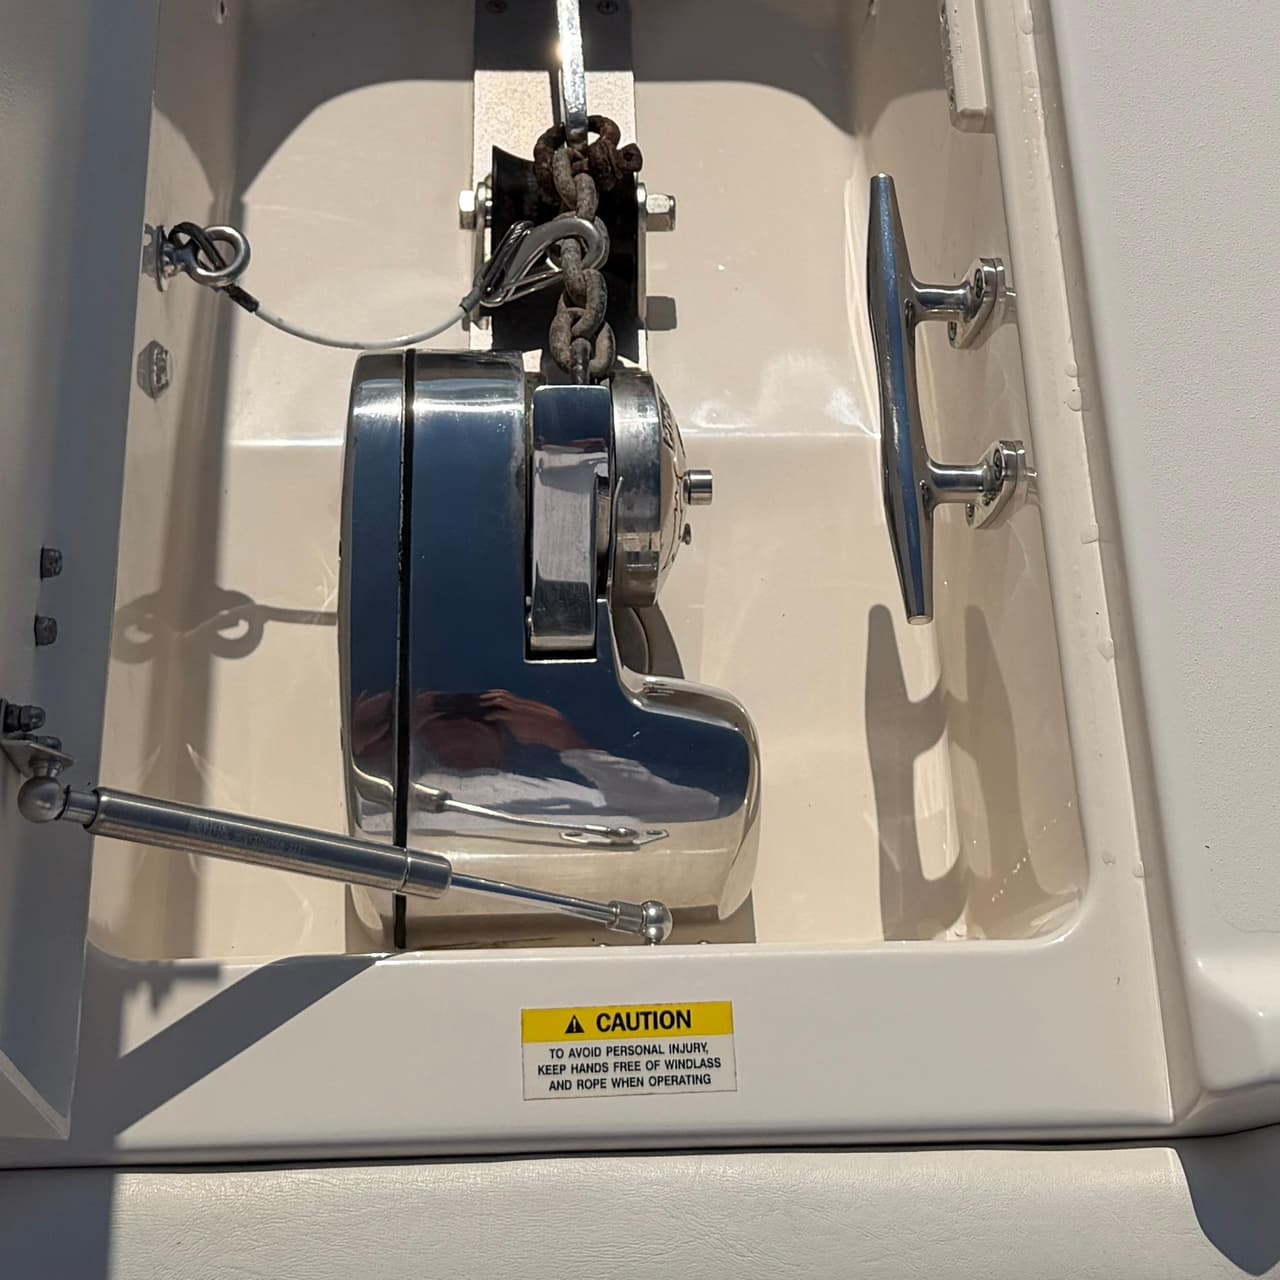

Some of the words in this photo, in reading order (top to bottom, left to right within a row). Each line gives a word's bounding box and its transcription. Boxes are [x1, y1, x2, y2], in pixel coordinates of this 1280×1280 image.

[596, 1009, 692, 1032] CAUTION
[549, 1048, 565, 1060] TO
[568, 1047, 602, 1059] AVOID
[606, 1044, 665, 1057] PERSONAL
[669, 1041, 709, 1055] INJURY,
[537, 1064, 567, 1076] KEEP
[571, 1062, 609, 1075] HANDS
[613, 1060, 642, 1073] FREE
[645, 1059, 661, 1071] OF
[664, 1057, 722, 1071] WINDLASS
[549, 1079, 573, 1092] AND
[577, 1078, 608, 1090] ROPE
[611, 1076, 645, 1089] WHEN
[648, 1073, 712, 1087] OPERATING
